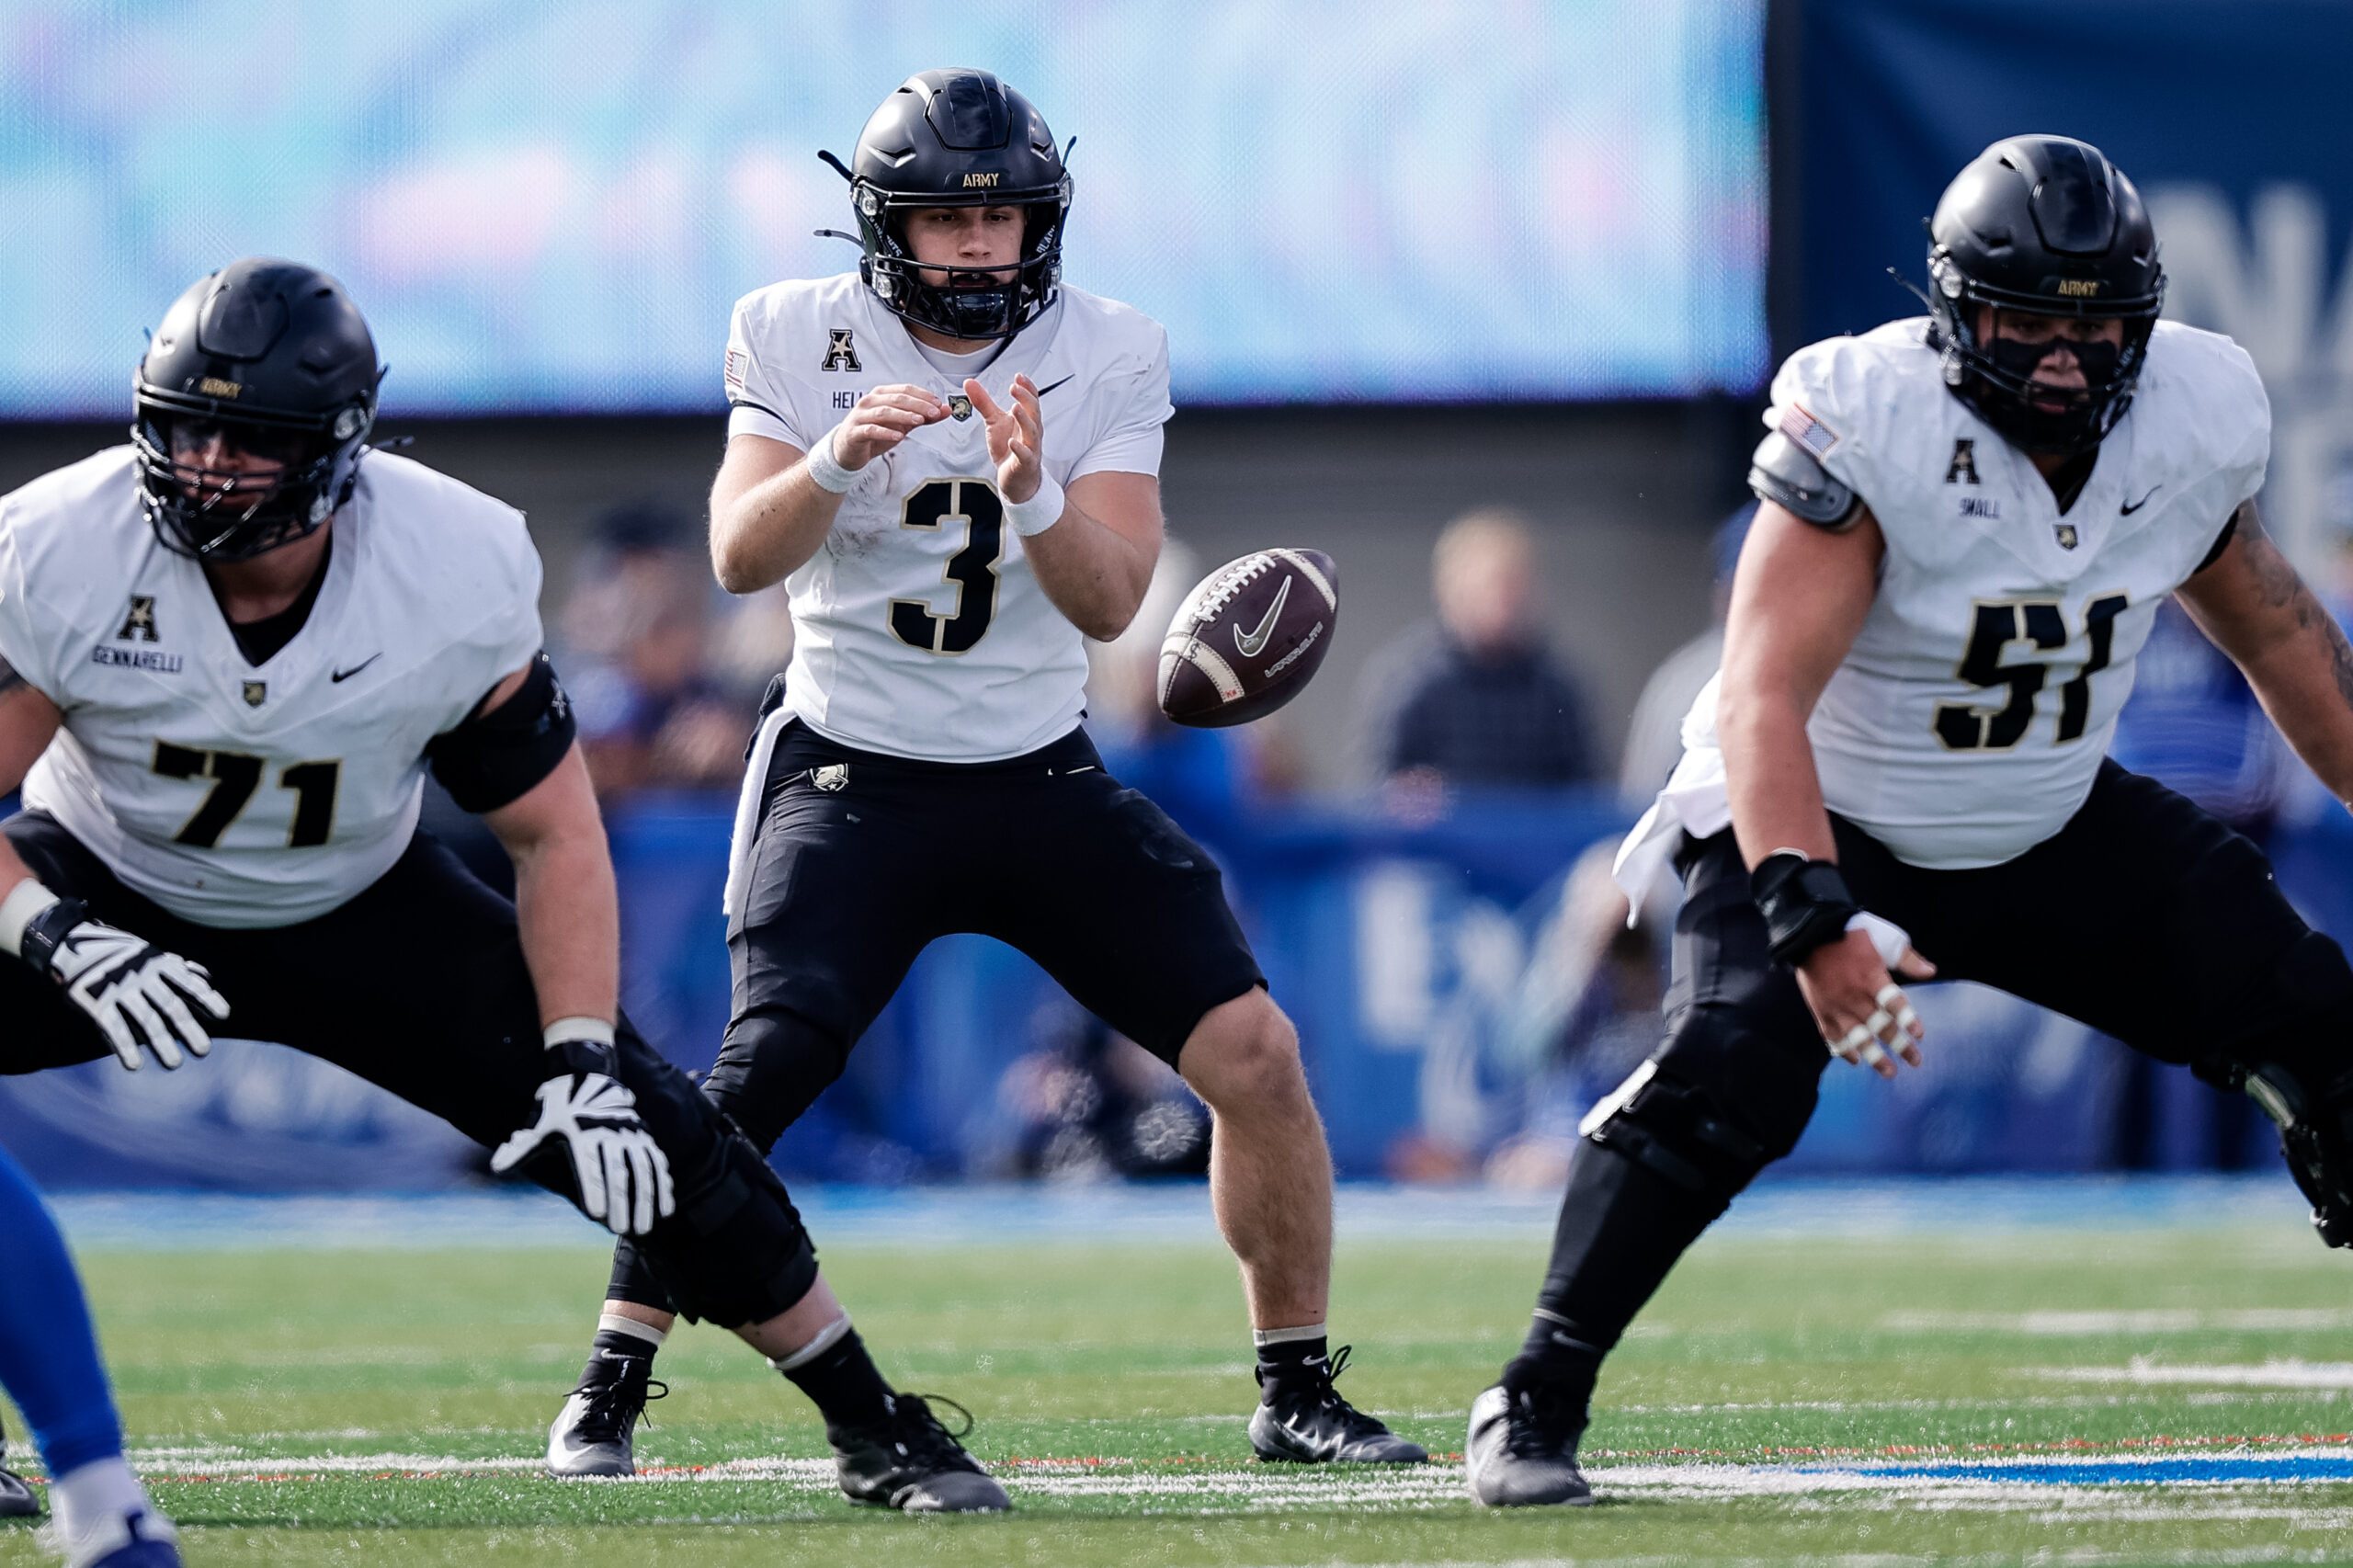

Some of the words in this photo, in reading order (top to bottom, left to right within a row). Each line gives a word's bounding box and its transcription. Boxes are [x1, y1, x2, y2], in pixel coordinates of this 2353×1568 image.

[962, 172, 1000, 187] ARMY
[2057, 279, 2101, 297] ARMY
[822, 329, 861, 371] A
[1946, 439, 1981, 484] A
[1959, 497, 2000, 520] SMALL
[887, 476, 1006, 658] 3
[118, 596, 160, 642] A
[1933, 592, 2133, 754] 51
[151, 738, 343, 849] 71
